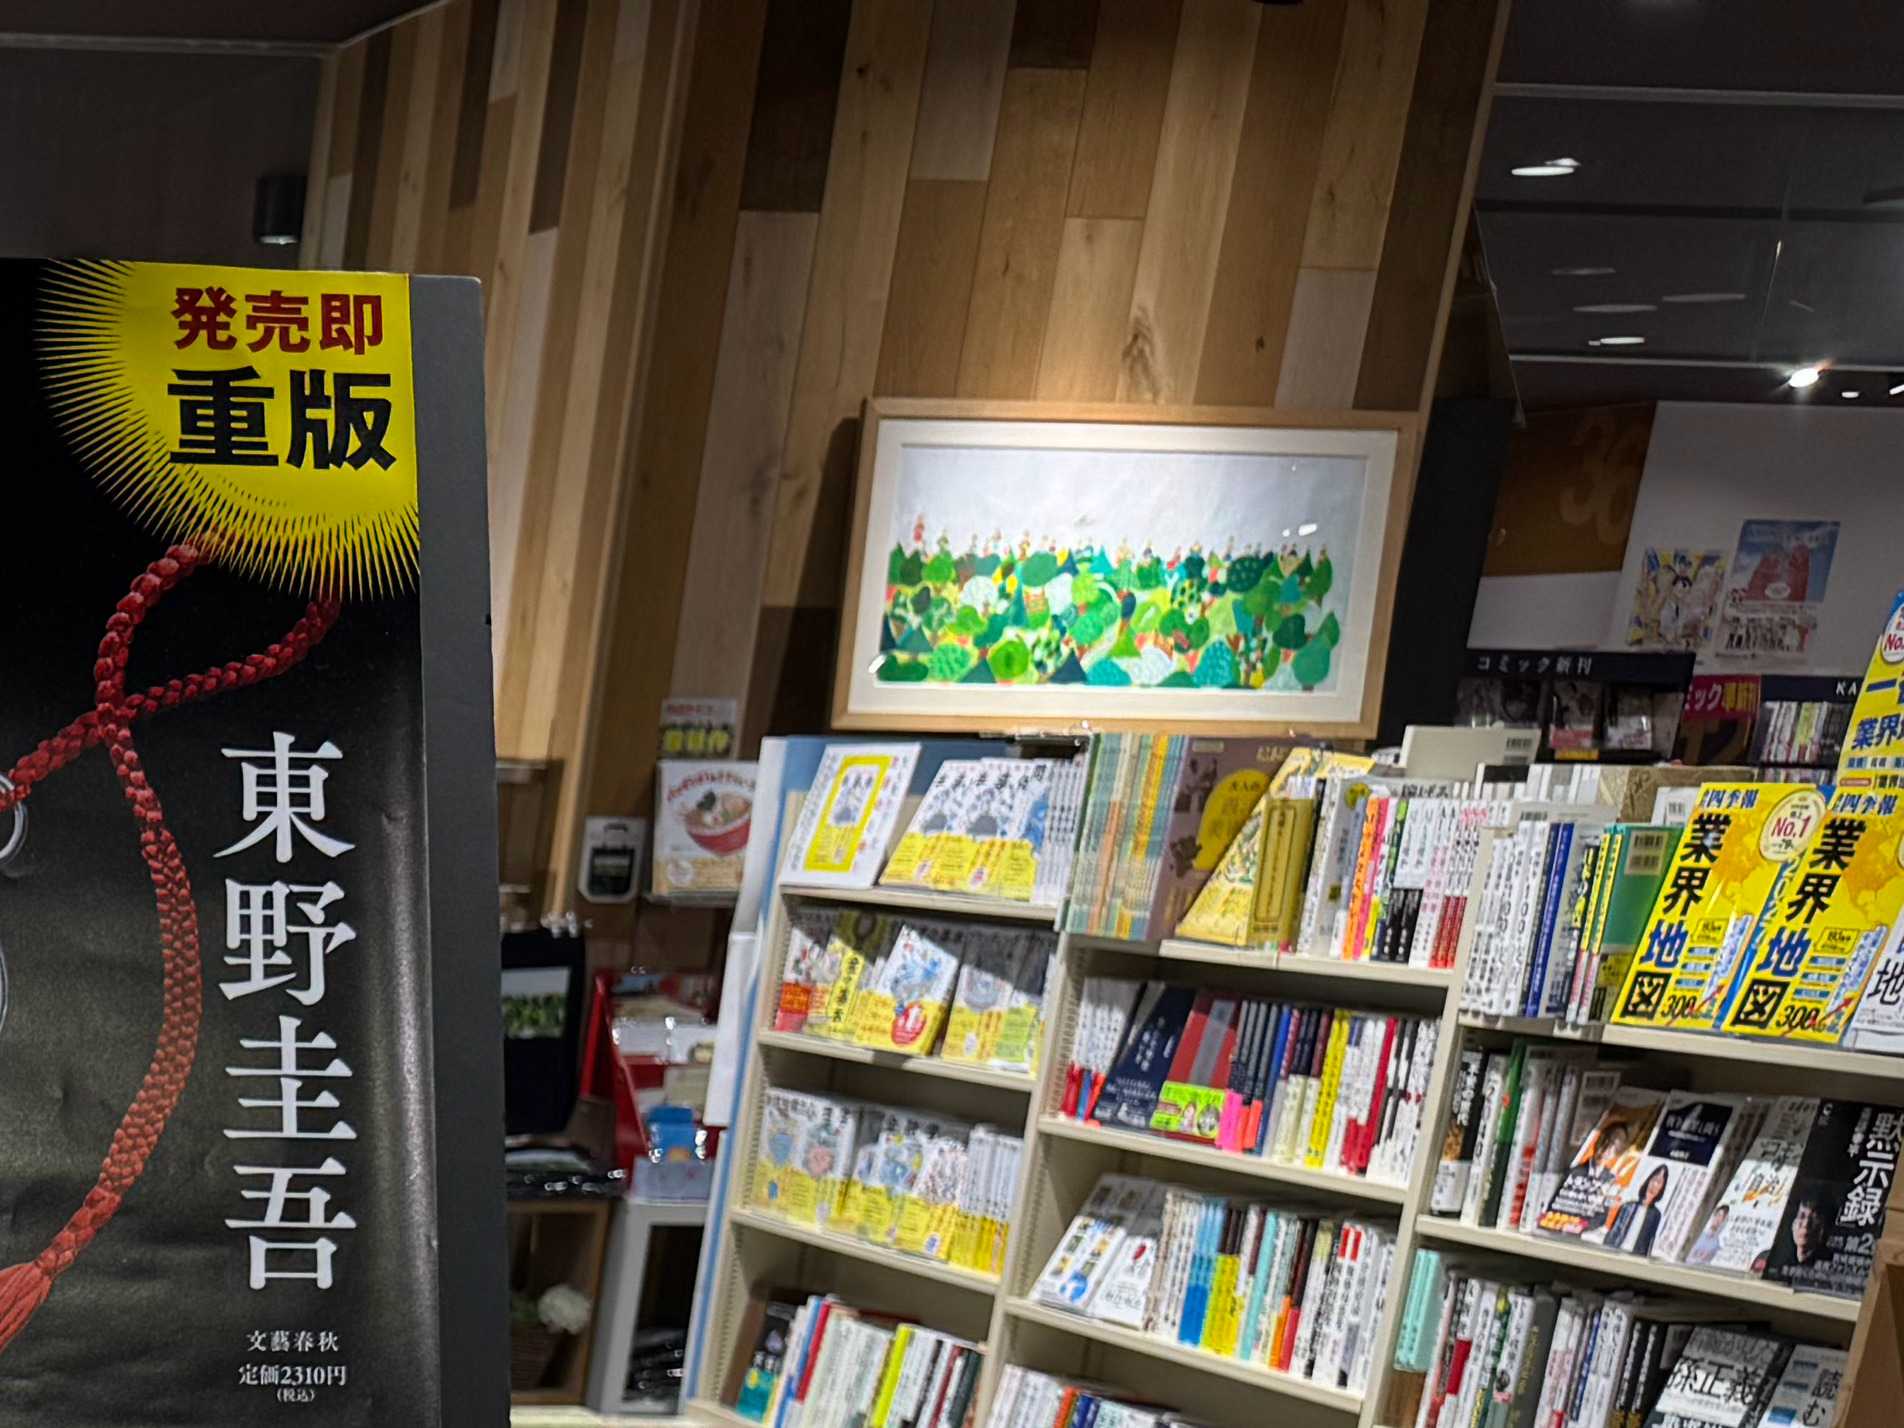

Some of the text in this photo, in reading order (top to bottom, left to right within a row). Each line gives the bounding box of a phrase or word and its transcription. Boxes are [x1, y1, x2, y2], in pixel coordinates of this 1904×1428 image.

[170, 287, 384, 353] 発売即
[167, 366, 397, 473] 重版
[1620, 813, 1732, 1021] 業界地図
[1731, 816, 1867, 1029] 業界地図
[211, 731, 357, 1293] 東野圭吾
[237, 1363, 347, 1389] 定価2310円
[245, 1330, 340, 1354] 文藝春秋
